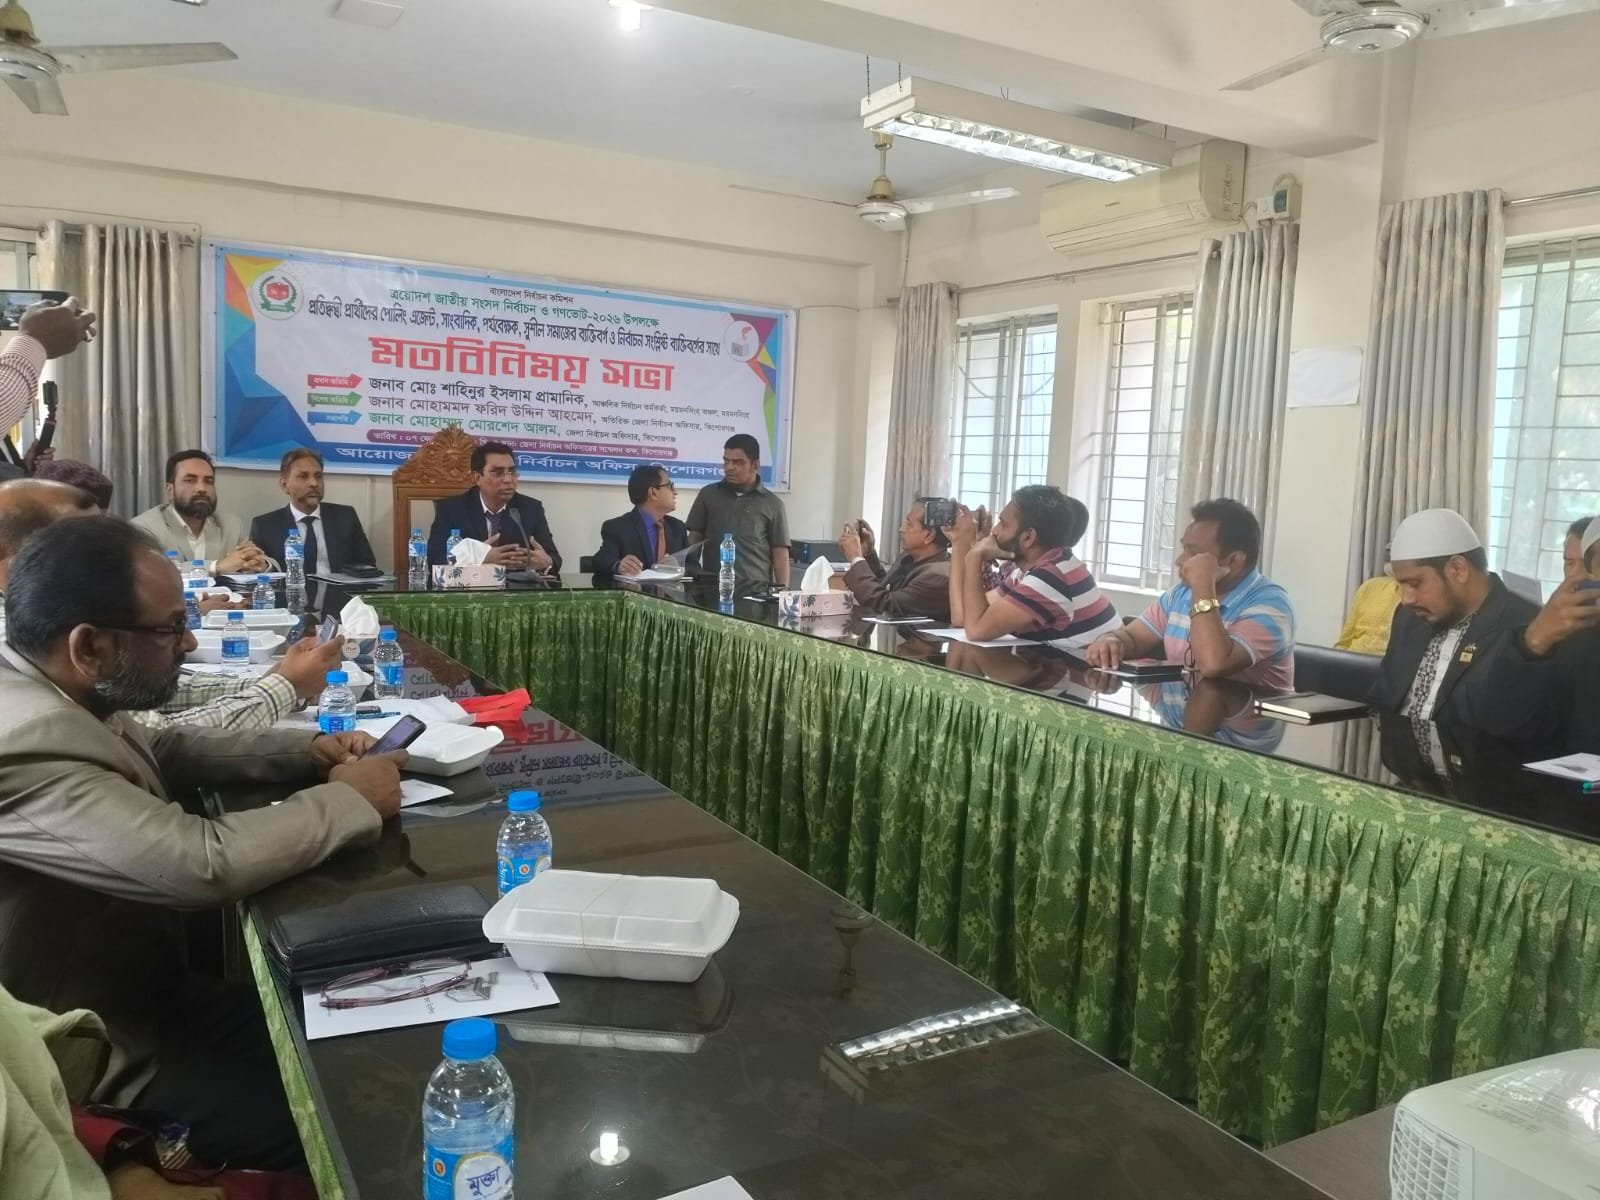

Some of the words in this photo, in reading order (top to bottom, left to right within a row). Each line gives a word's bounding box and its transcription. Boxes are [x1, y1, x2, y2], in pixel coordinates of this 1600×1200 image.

[389, 288, 431, 303] ত্রয়োদশ
[435, 291, 468, 307] জাতীয়
[471, 298, 500, 311] সংসদ
[502, 298, 537, 316] নির্বাচন
[540, 306, 549, 316] ও
[552, 305, 621, 325] গণভোট-২০২৬
[623, 312, 660, 328] উপলক্ষে
[489, 287, 521, 298] বাংলাদেশ
[524, 289, 547, 301] নির্বাচন
[344, 298, 378, 321] প্রার্থীদের
[380, 302, 408, 326] পোলিং
[410, 307, 439, 328] এজেন্ট,
[441, 309, 480, 333] সাংবাদিক,
[483, 315, 521, 337] পর্যবেক্ষক,
[523, 317, 545, 341] সুশীল
[546, 323, 577, 341] সমাজের
[578, 323, 608, 345] ব্যক্তিবর্গ
[609, 331, 616, 345] ও
[617, 327, 644, 347] নির্বাচন
[645, 330, 669, 352] সংশ্লিষ্ট
[368, 336, 590, 389] মতবিনিময়
[600, 359, 674, 391] সভা
[368, 377, 405, 392] জনাব
[410, 380, 437, 395] মোঃ
[440, 380, 486, 401] শাহিনুর
[489, 384, 531, 401] ইসলাম
[536, 389, 588, 409] প্রামানিক,
[368, 395, 405, 410] জনাব
[474, 401, 508, 416] ফরিদ
[511, 403, 544, 419] উদ্দিন
[548, 408, 597, 425] আহমেদ,
[368, 412, 405, 425] জনাব
[468, 419, 520, 433] মোরশেদ
[523, 422, 561, 437] আলম,
[566, 429, 584, 437] জেলা
[336, 447, 417, 460] আয়োজ
[517, 454, 580, 469] নির্বাচন
[466, 1166, 500, 1197] মুক্তা
